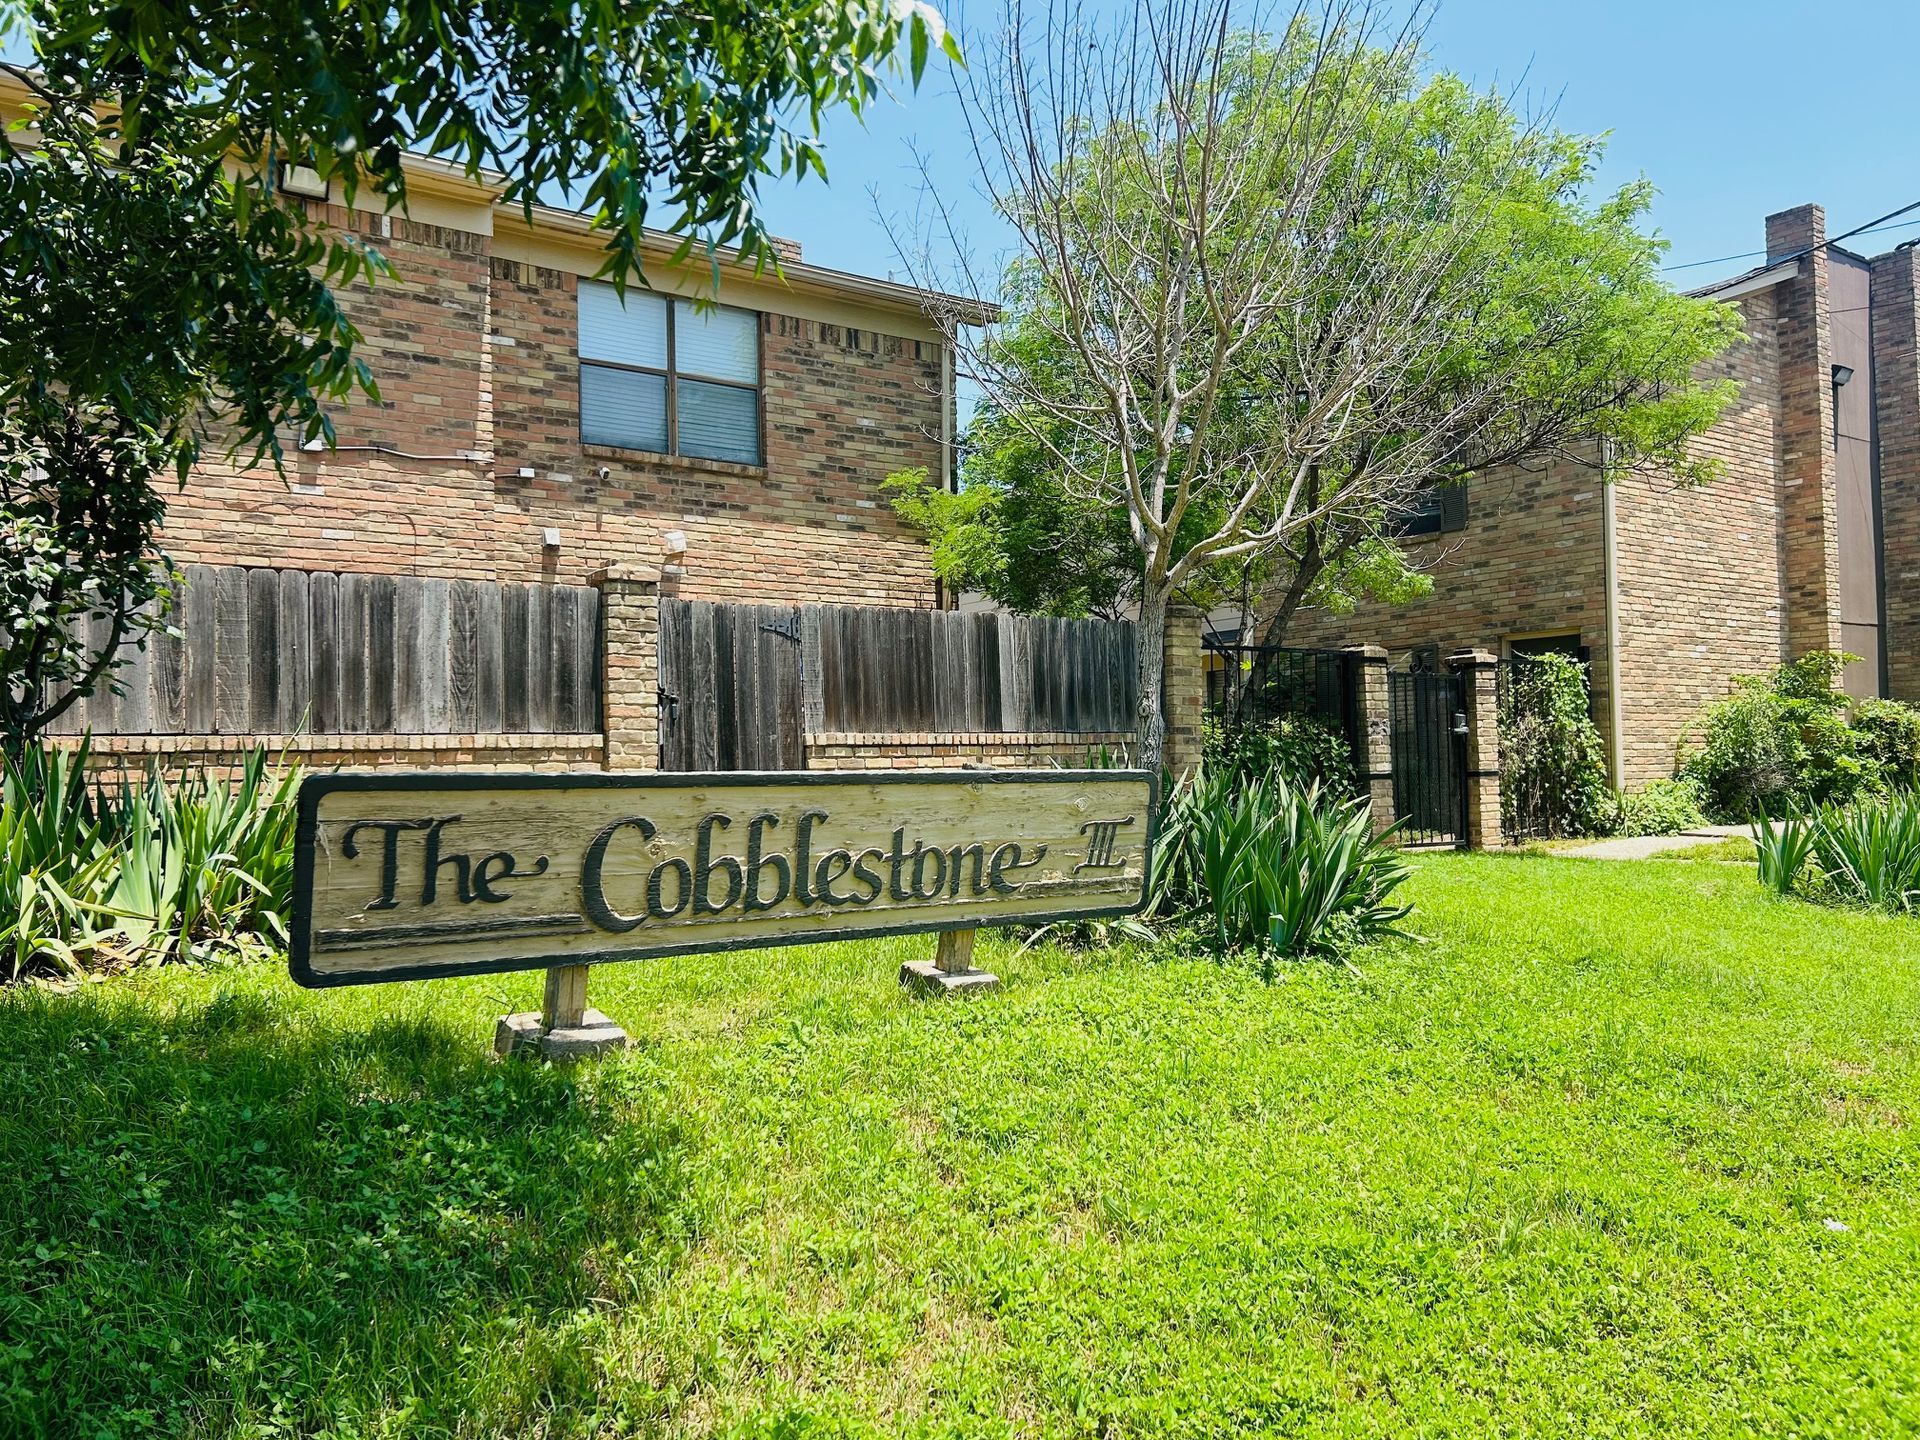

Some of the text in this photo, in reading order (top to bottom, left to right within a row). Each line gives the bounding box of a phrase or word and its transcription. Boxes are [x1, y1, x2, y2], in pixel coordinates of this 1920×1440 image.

[341, 808, 1136, 933] The Cobblestone III
